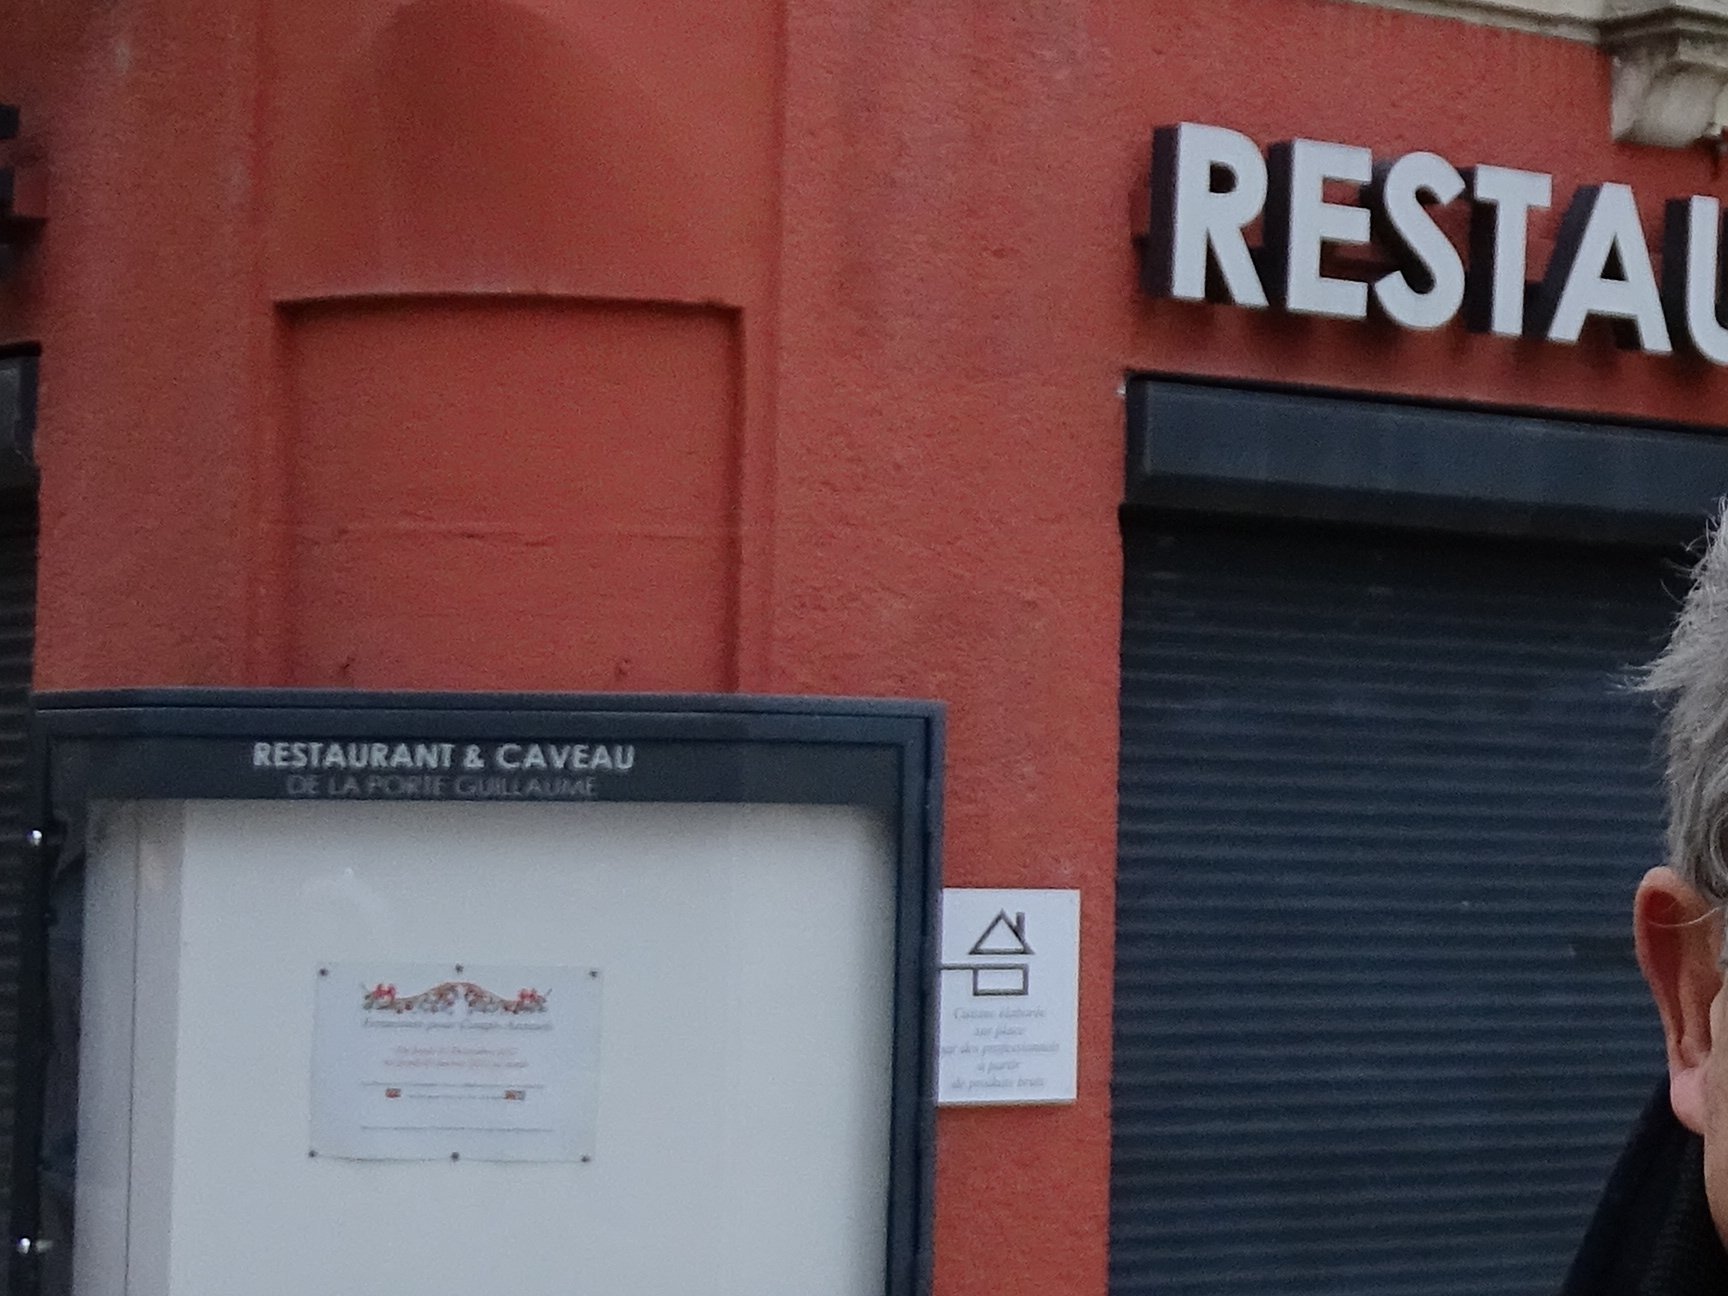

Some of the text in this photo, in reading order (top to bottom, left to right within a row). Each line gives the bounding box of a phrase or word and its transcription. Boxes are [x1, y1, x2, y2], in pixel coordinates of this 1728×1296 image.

[252, 741, 636, 770] RESTAURANT & CAVEAU
